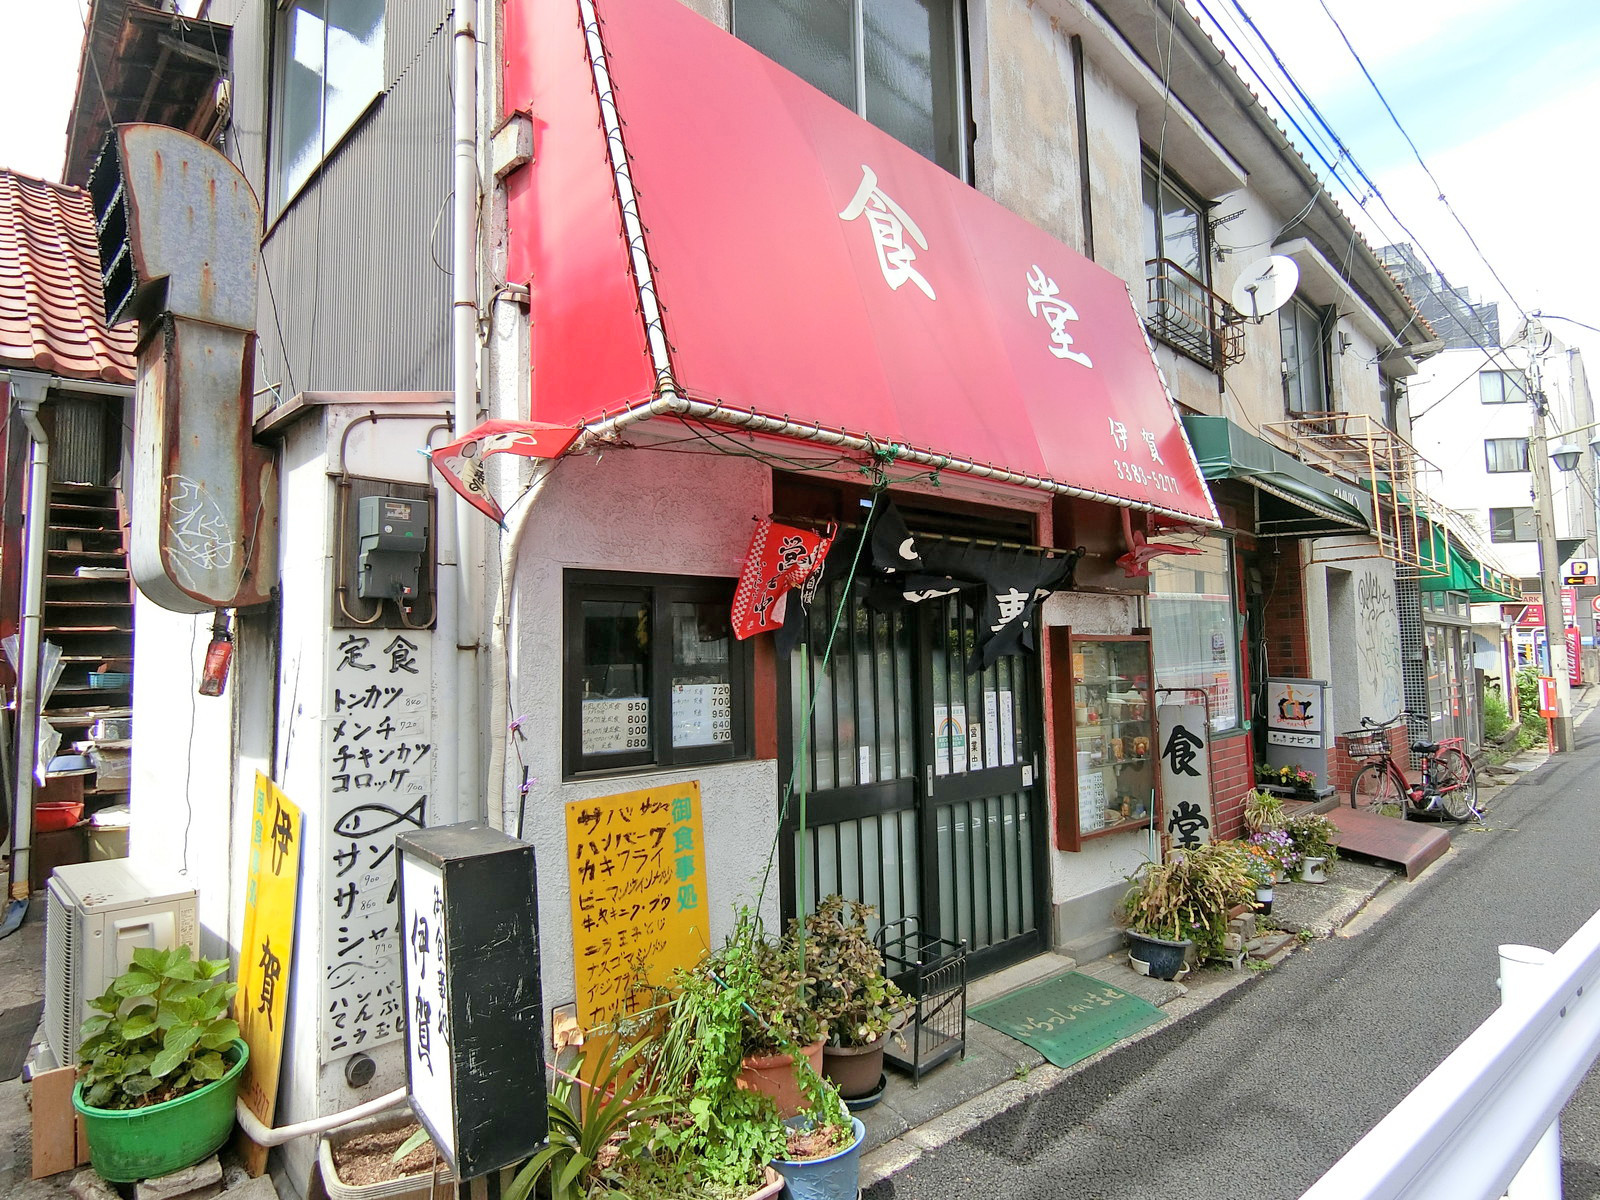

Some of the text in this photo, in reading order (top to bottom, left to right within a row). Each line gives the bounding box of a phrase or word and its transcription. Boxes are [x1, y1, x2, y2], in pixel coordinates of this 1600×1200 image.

[839, 165, 1093, 368] 食堂
[1108, 417, 1164, 466] 伊賀
[1113, 460, 1179, 495] 3383-5277
[1573, 561, 1588, 575] P
[337, 635, 419, 674] 定食
[335, 685, 403, 712] トンカツ
[712, 698, 730, 706] 700
[713, 687, 729, 695] 720
[628, 702, 647, 711] 950
[712, 710, 730, 718] 950
[333, 716, 395, 742] メンチ
[400, 721, 417, 730] 720
[627, 715, 647, 723] 800
[628, 726, 647, 735] 900
[713, 720, 729, 729] 640
[626, 739, 647, 747] 880
[713, 731, 730, 740] 670
[1289, 736, 1315, 744] ナビオ
[333, 743, 431, 772] チキンカツ
[332, 769, 410, 793] コロッケ
[407, 782, 423, 793] 700
[1162, 725, 1209, 850] 食堂
[577, 797, 670, 835] サバ サンマ
[576, 822, 670, 860] ハンバーグ
[578, 847, 664, 885] カキフライ
[671, 797, 698, 913] 御食事処
[365, 875, 380, 886] 900
[258, 797, 293, 1032] 伊賀
[360, 900, 376, 911] 860
[338, 921, 400, 957] シャ
[375, 944, 392, 955] 790
[411, 908, 435, 1077] 伊賀
[1017, 988, 1126, 1037] いらっしゃいませ
